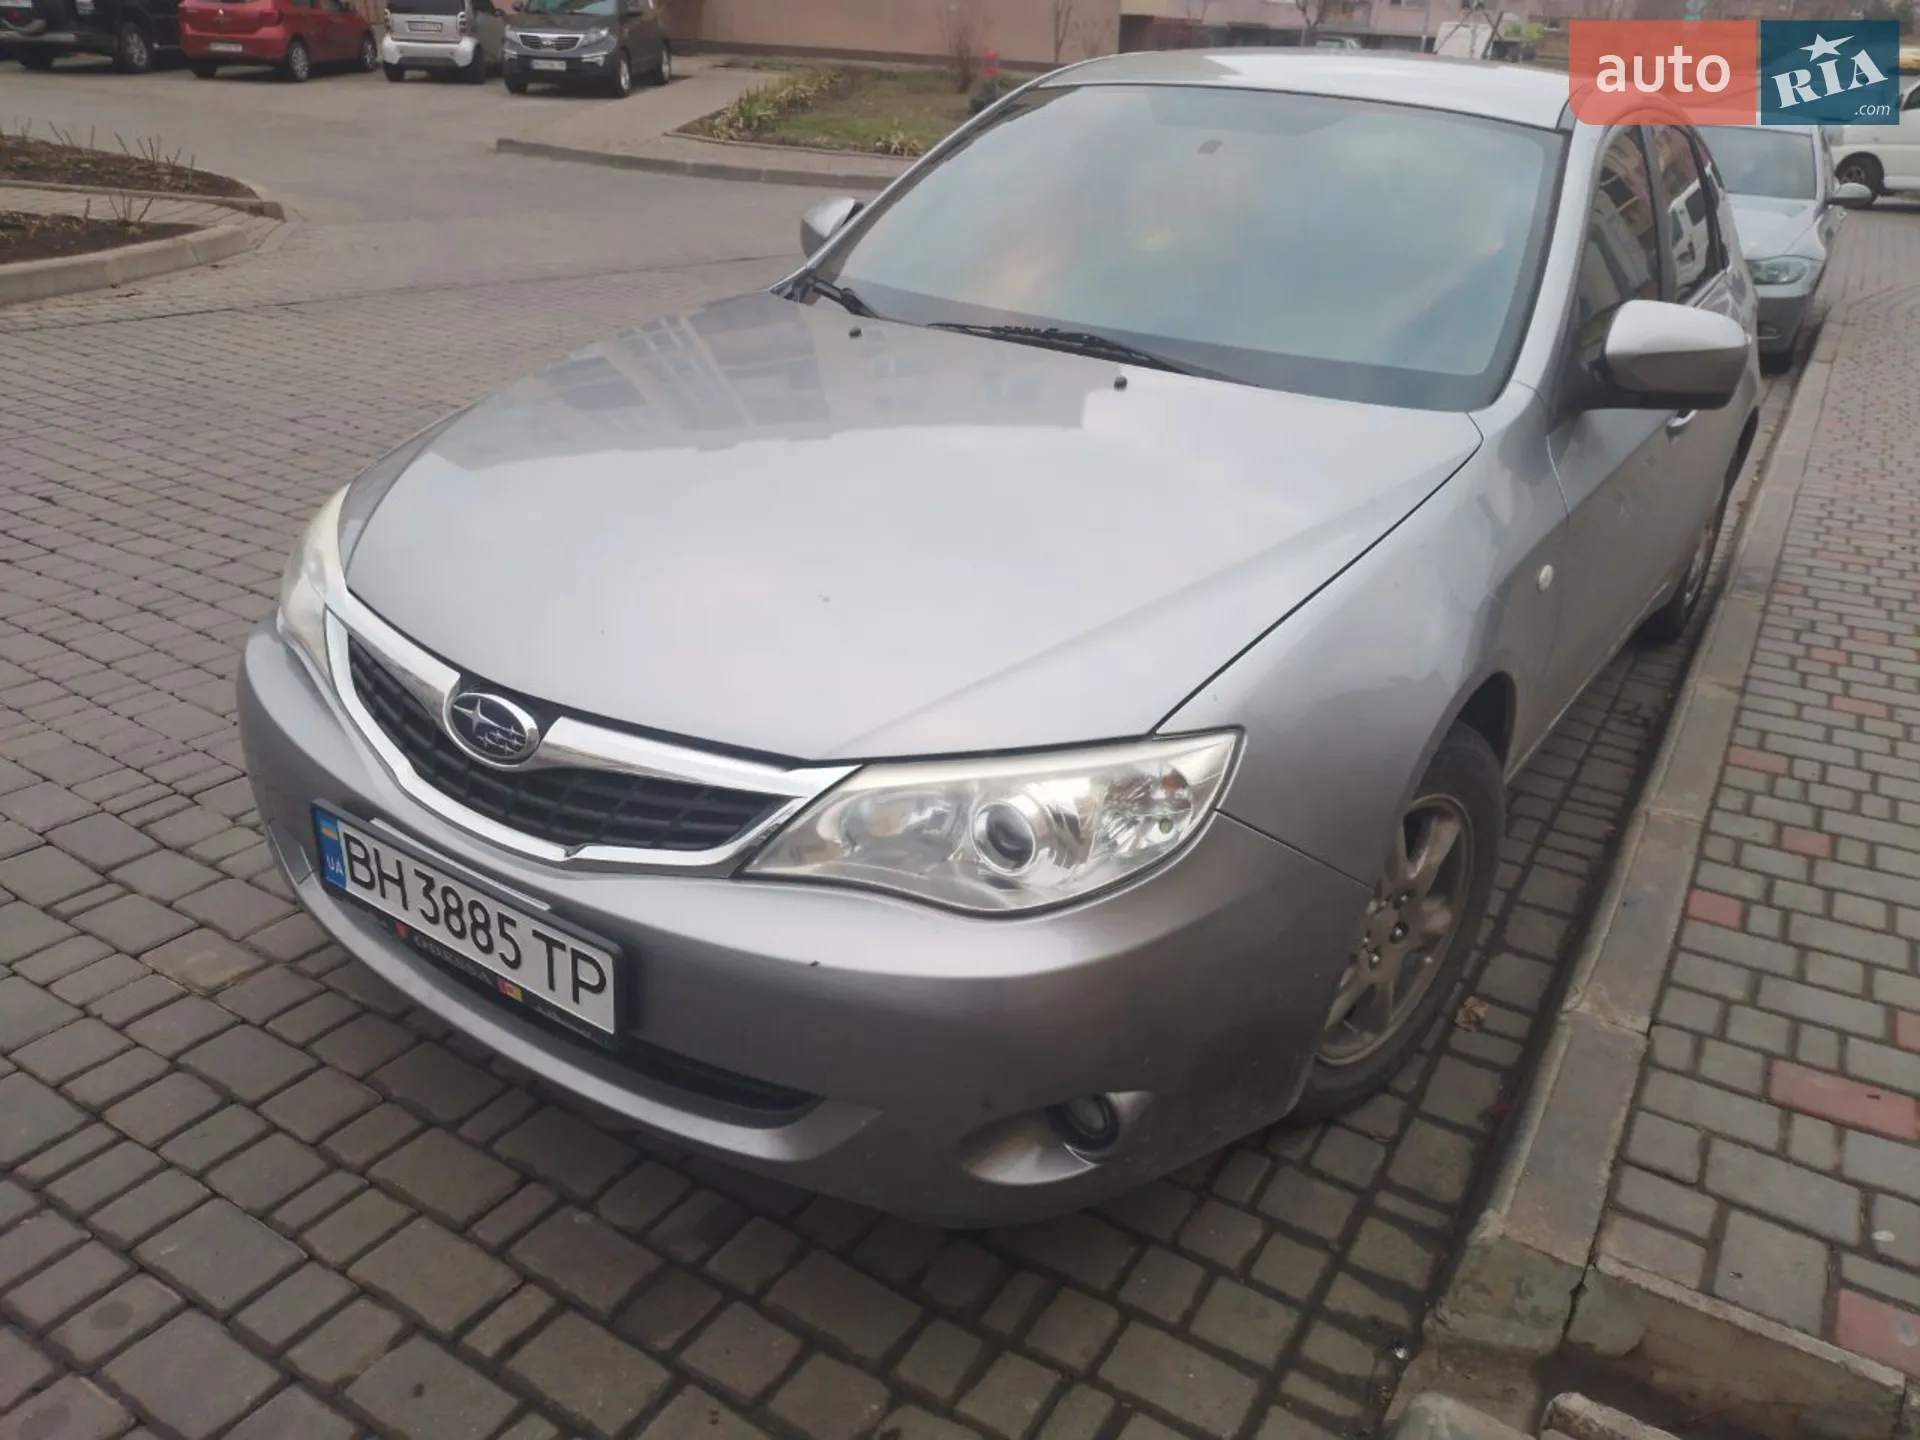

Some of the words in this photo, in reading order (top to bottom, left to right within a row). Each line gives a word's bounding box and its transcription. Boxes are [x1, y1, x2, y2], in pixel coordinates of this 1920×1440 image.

[326, 854, 344, 877] UA
[343, 831, 409, 912] BH
[413, 867, 522, 970] 3885
[531, 928, 607, 1005] TP
